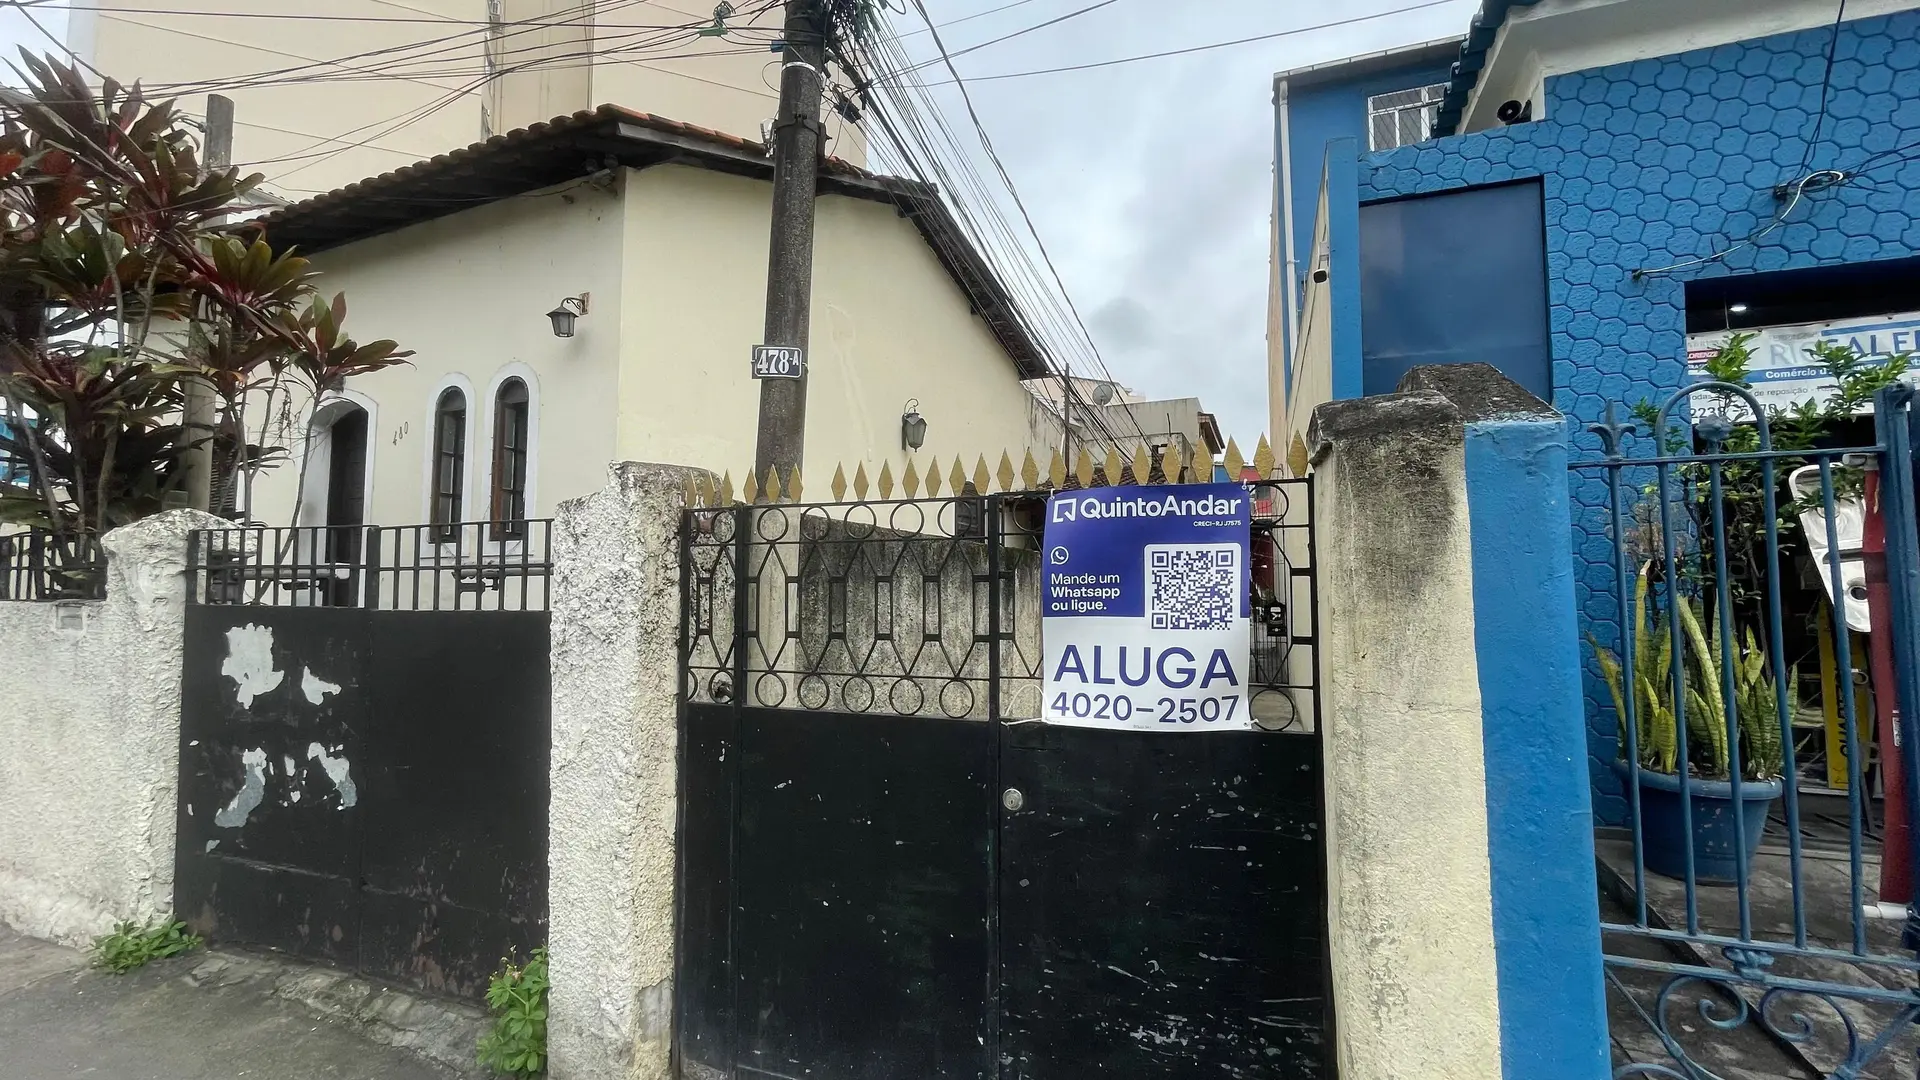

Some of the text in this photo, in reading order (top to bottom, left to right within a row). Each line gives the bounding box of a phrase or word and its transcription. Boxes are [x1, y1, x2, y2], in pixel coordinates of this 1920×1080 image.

[757, 350, 799, 374] 478-A
[1765, 367, 1817, 379] Comércio
[1766, 387, 1809, 396] reposição
[1080, 494, 1242, 520] QuintoAndar
[1051, 573, 1120, 585] Mande um
[1051, 587, 1121, 600] Whatsapp
[1071, 600, 1107, 613] ligue.
[1053, 644, 1239, 689] ALUGA
[1050, 692, 1240, 723] 4020-2507
